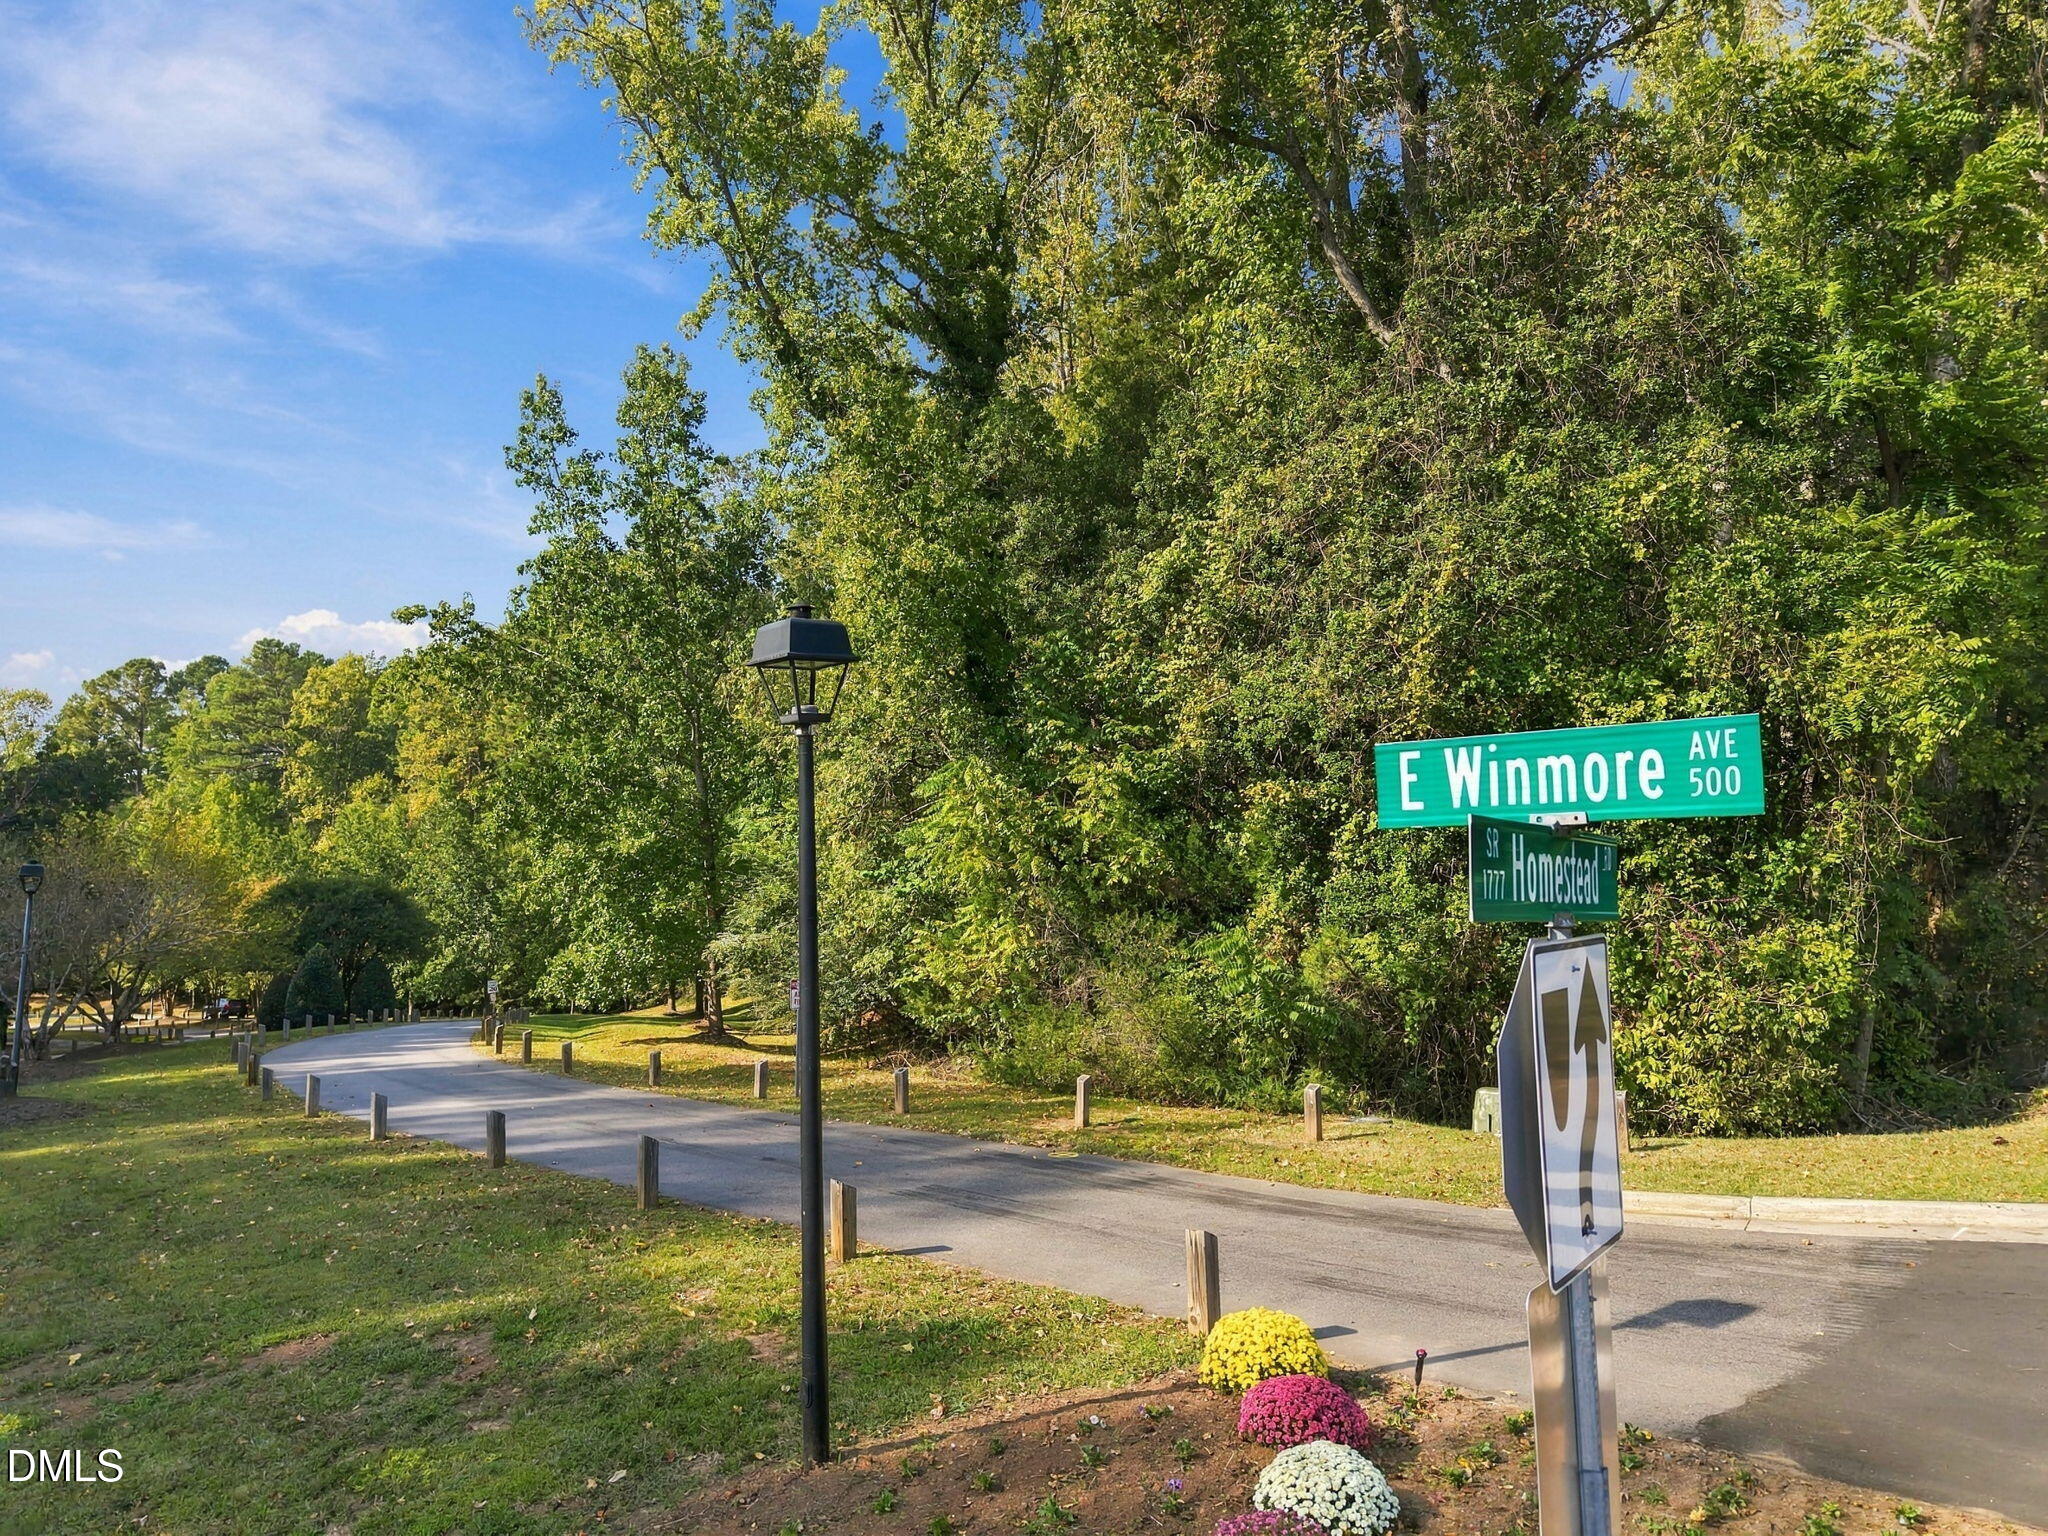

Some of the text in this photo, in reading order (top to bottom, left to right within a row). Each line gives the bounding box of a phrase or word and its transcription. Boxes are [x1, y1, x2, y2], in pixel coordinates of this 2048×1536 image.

[1399, 728, 1737, 811] E Winmore AVE
[1689, 765, 1741, 798] 500
[1486, 827, 1499, 858] SR
[1483, 868, 1506, 900] 1777
[1512, 832, 1600, 905] Homestead
